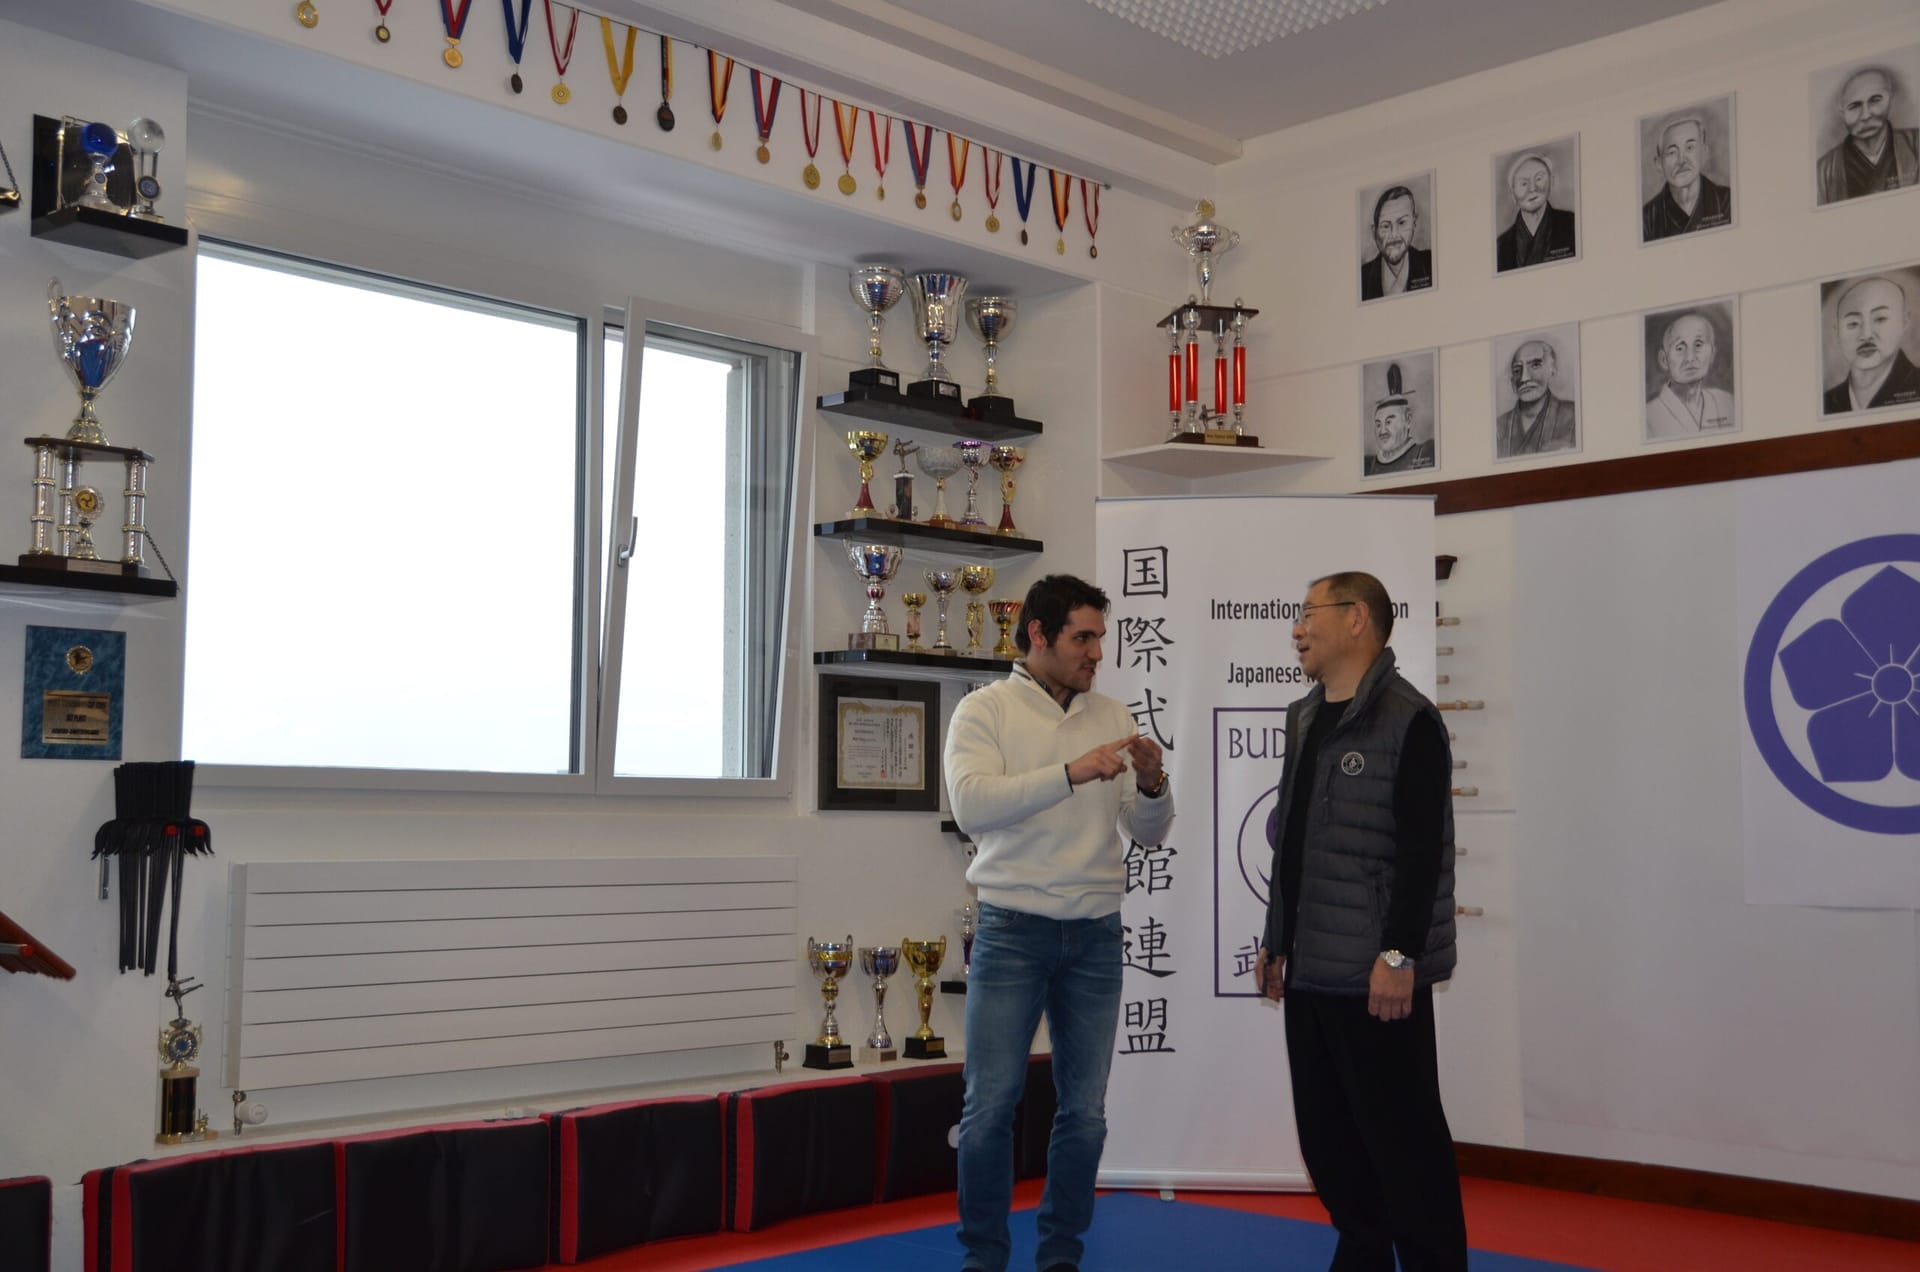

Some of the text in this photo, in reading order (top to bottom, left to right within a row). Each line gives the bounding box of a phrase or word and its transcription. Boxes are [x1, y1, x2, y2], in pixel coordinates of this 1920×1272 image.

[1211, 598, 1301, 620] Internation
[1227, 662, 1302, 688] Japanese
[1228, 727, 1287, 759] BUD
[1117, 546, 1178, 1055] 国際武館連盟
